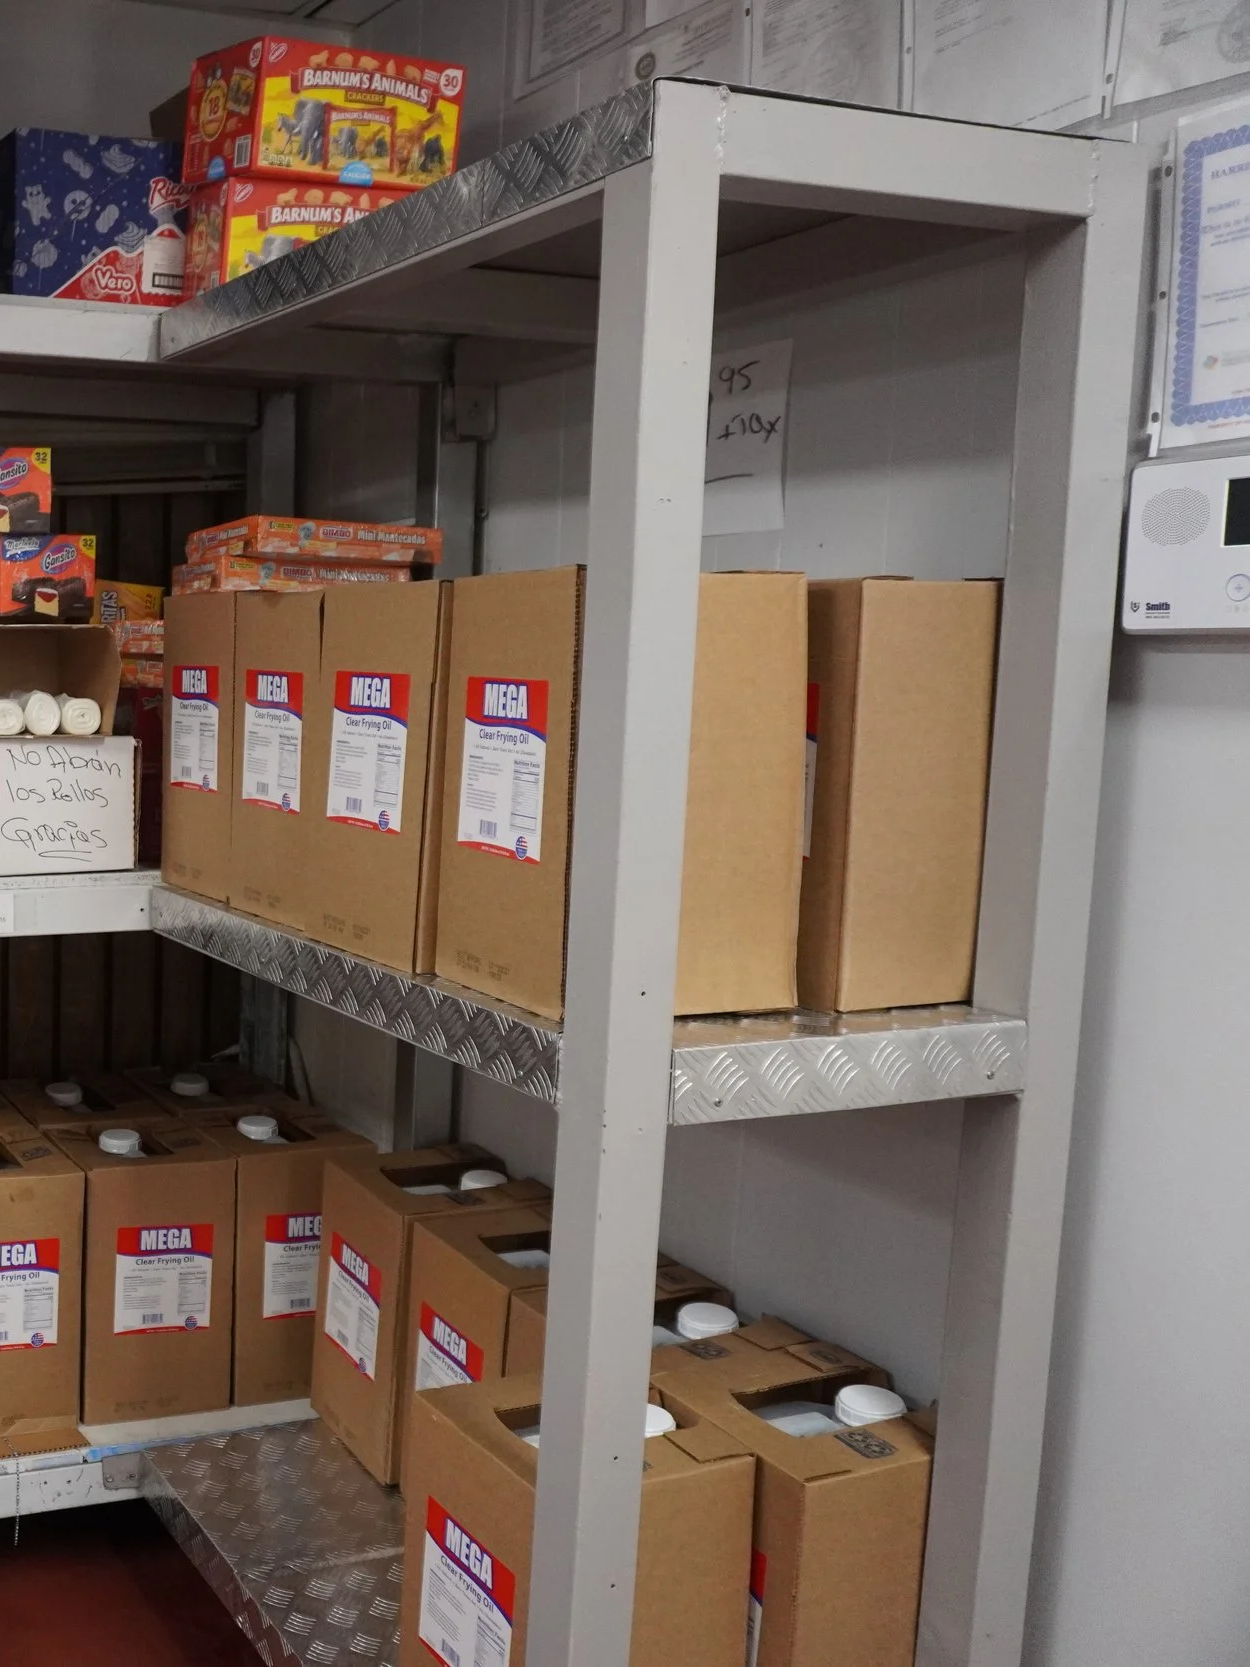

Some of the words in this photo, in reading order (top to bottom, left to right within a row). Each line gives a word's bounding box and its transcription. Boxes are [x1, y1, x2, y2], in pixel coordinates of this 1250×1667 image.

[304, 69, 369, 88] BARNUM'S
[372, 73, 428, 103] ANIMALS
[443, 74, 458, 88] 30
[271, 207, 341, 222] BARNUM'S
[101, 270, 132, 290] Vero
[35, 452, 47, 460] 32
[83, 539, 93, 547] 32
[44, 548, 76, 569] Gansito
[1146, 602, 1170, 611] Smith
[258, 675, 288, 703] MEGA
[351, 677, 390, 708] MEGA
[485, 683, 527, 719] MEGA
[479, 729, 495, 740] Clear
[497, 731, 517, 745] Frying
[519, 734, 529, 744] Oil
[141, 1228, 191, 1250] MEGA
[446, 1518, 493, 1589] MEGA
